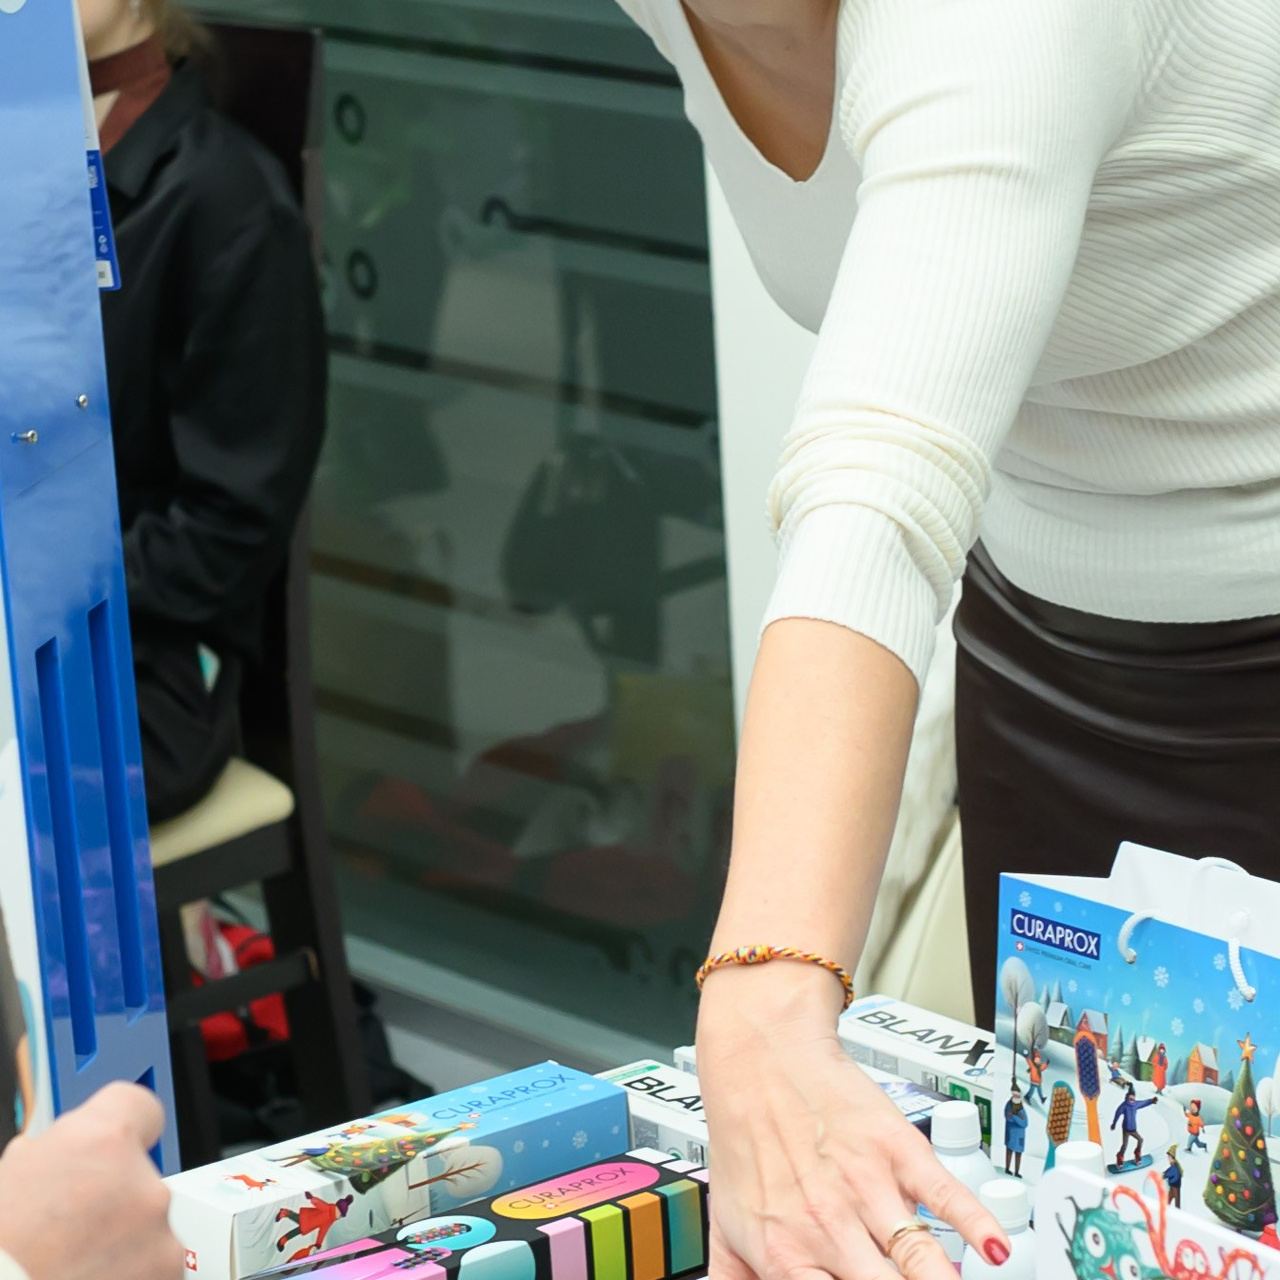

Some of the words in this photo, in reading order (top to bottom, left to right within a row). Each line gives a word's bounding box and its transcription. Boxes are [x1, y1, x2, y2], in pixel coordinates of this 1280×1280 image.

[1012, 913, 1098, 956] CURAPROX
[432, 1073, 576, 1121] CURAPROX
[623, 1075, 704, 1114] BLA
[508, 1166, 636, 1210] CURAPROX
